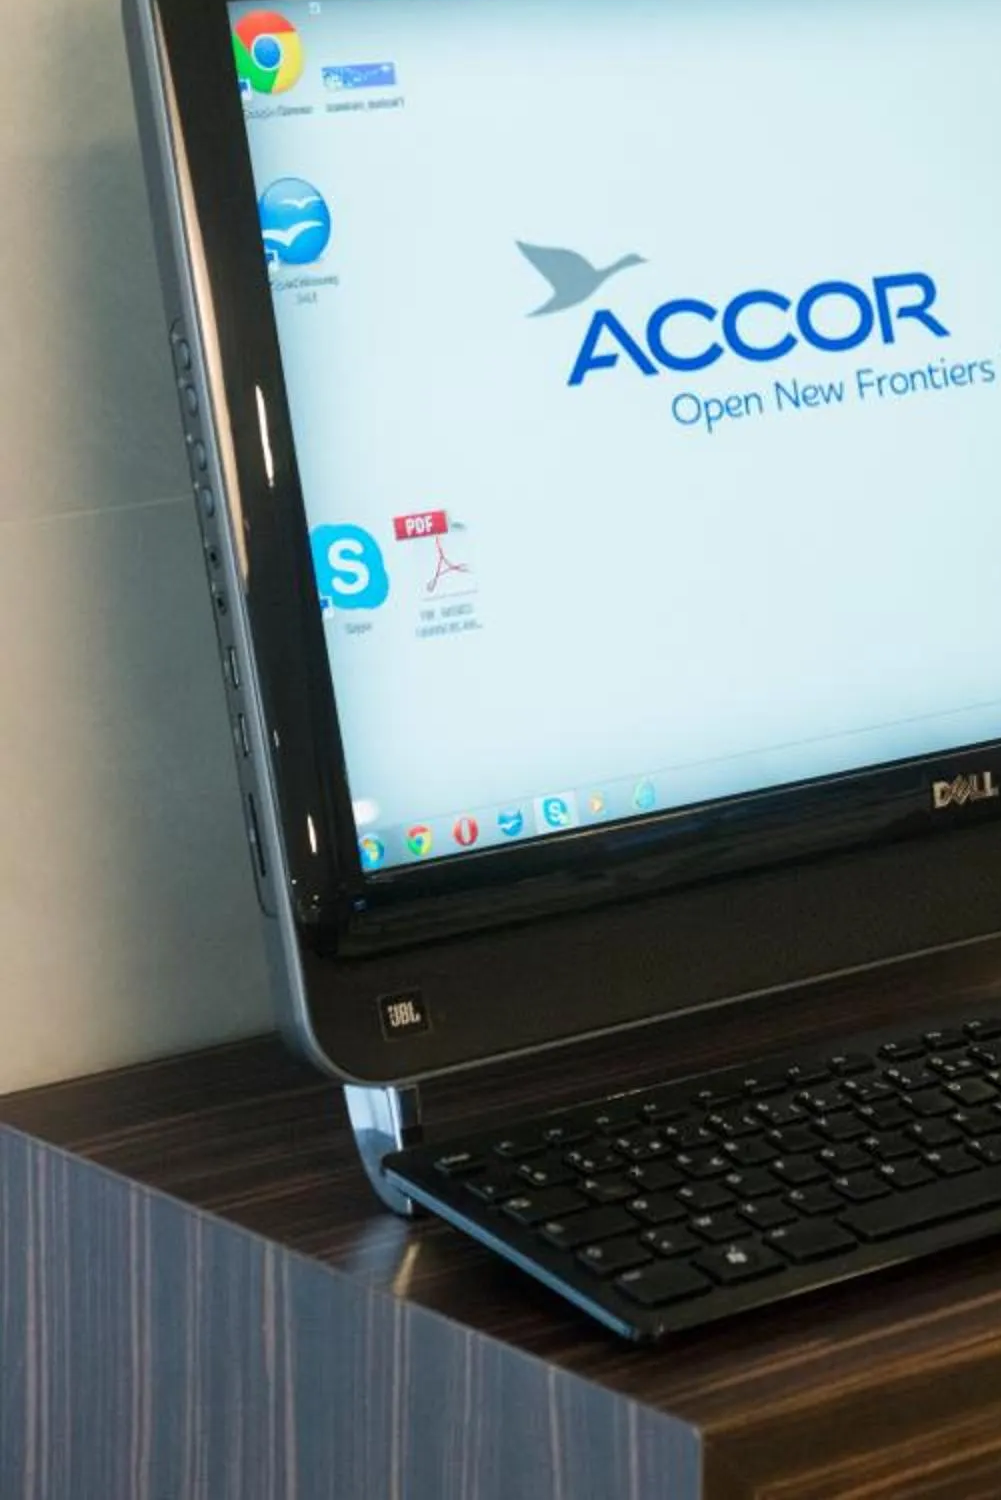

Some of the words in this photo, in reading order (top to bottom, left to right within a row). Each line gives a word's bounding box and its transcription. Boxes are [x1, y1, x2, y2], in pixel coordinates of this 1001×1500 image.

[567, 271, 951, 387] ACCOR
[672, 391, 763, 434] Open
[774, 378, 845, 412] New
[856, 357, 996, 400] Frontiers
[405, 514, 434, 537] PDF
[932, 771, 999, 809] DELL
[387, 1001, 421, 1027] JBL
